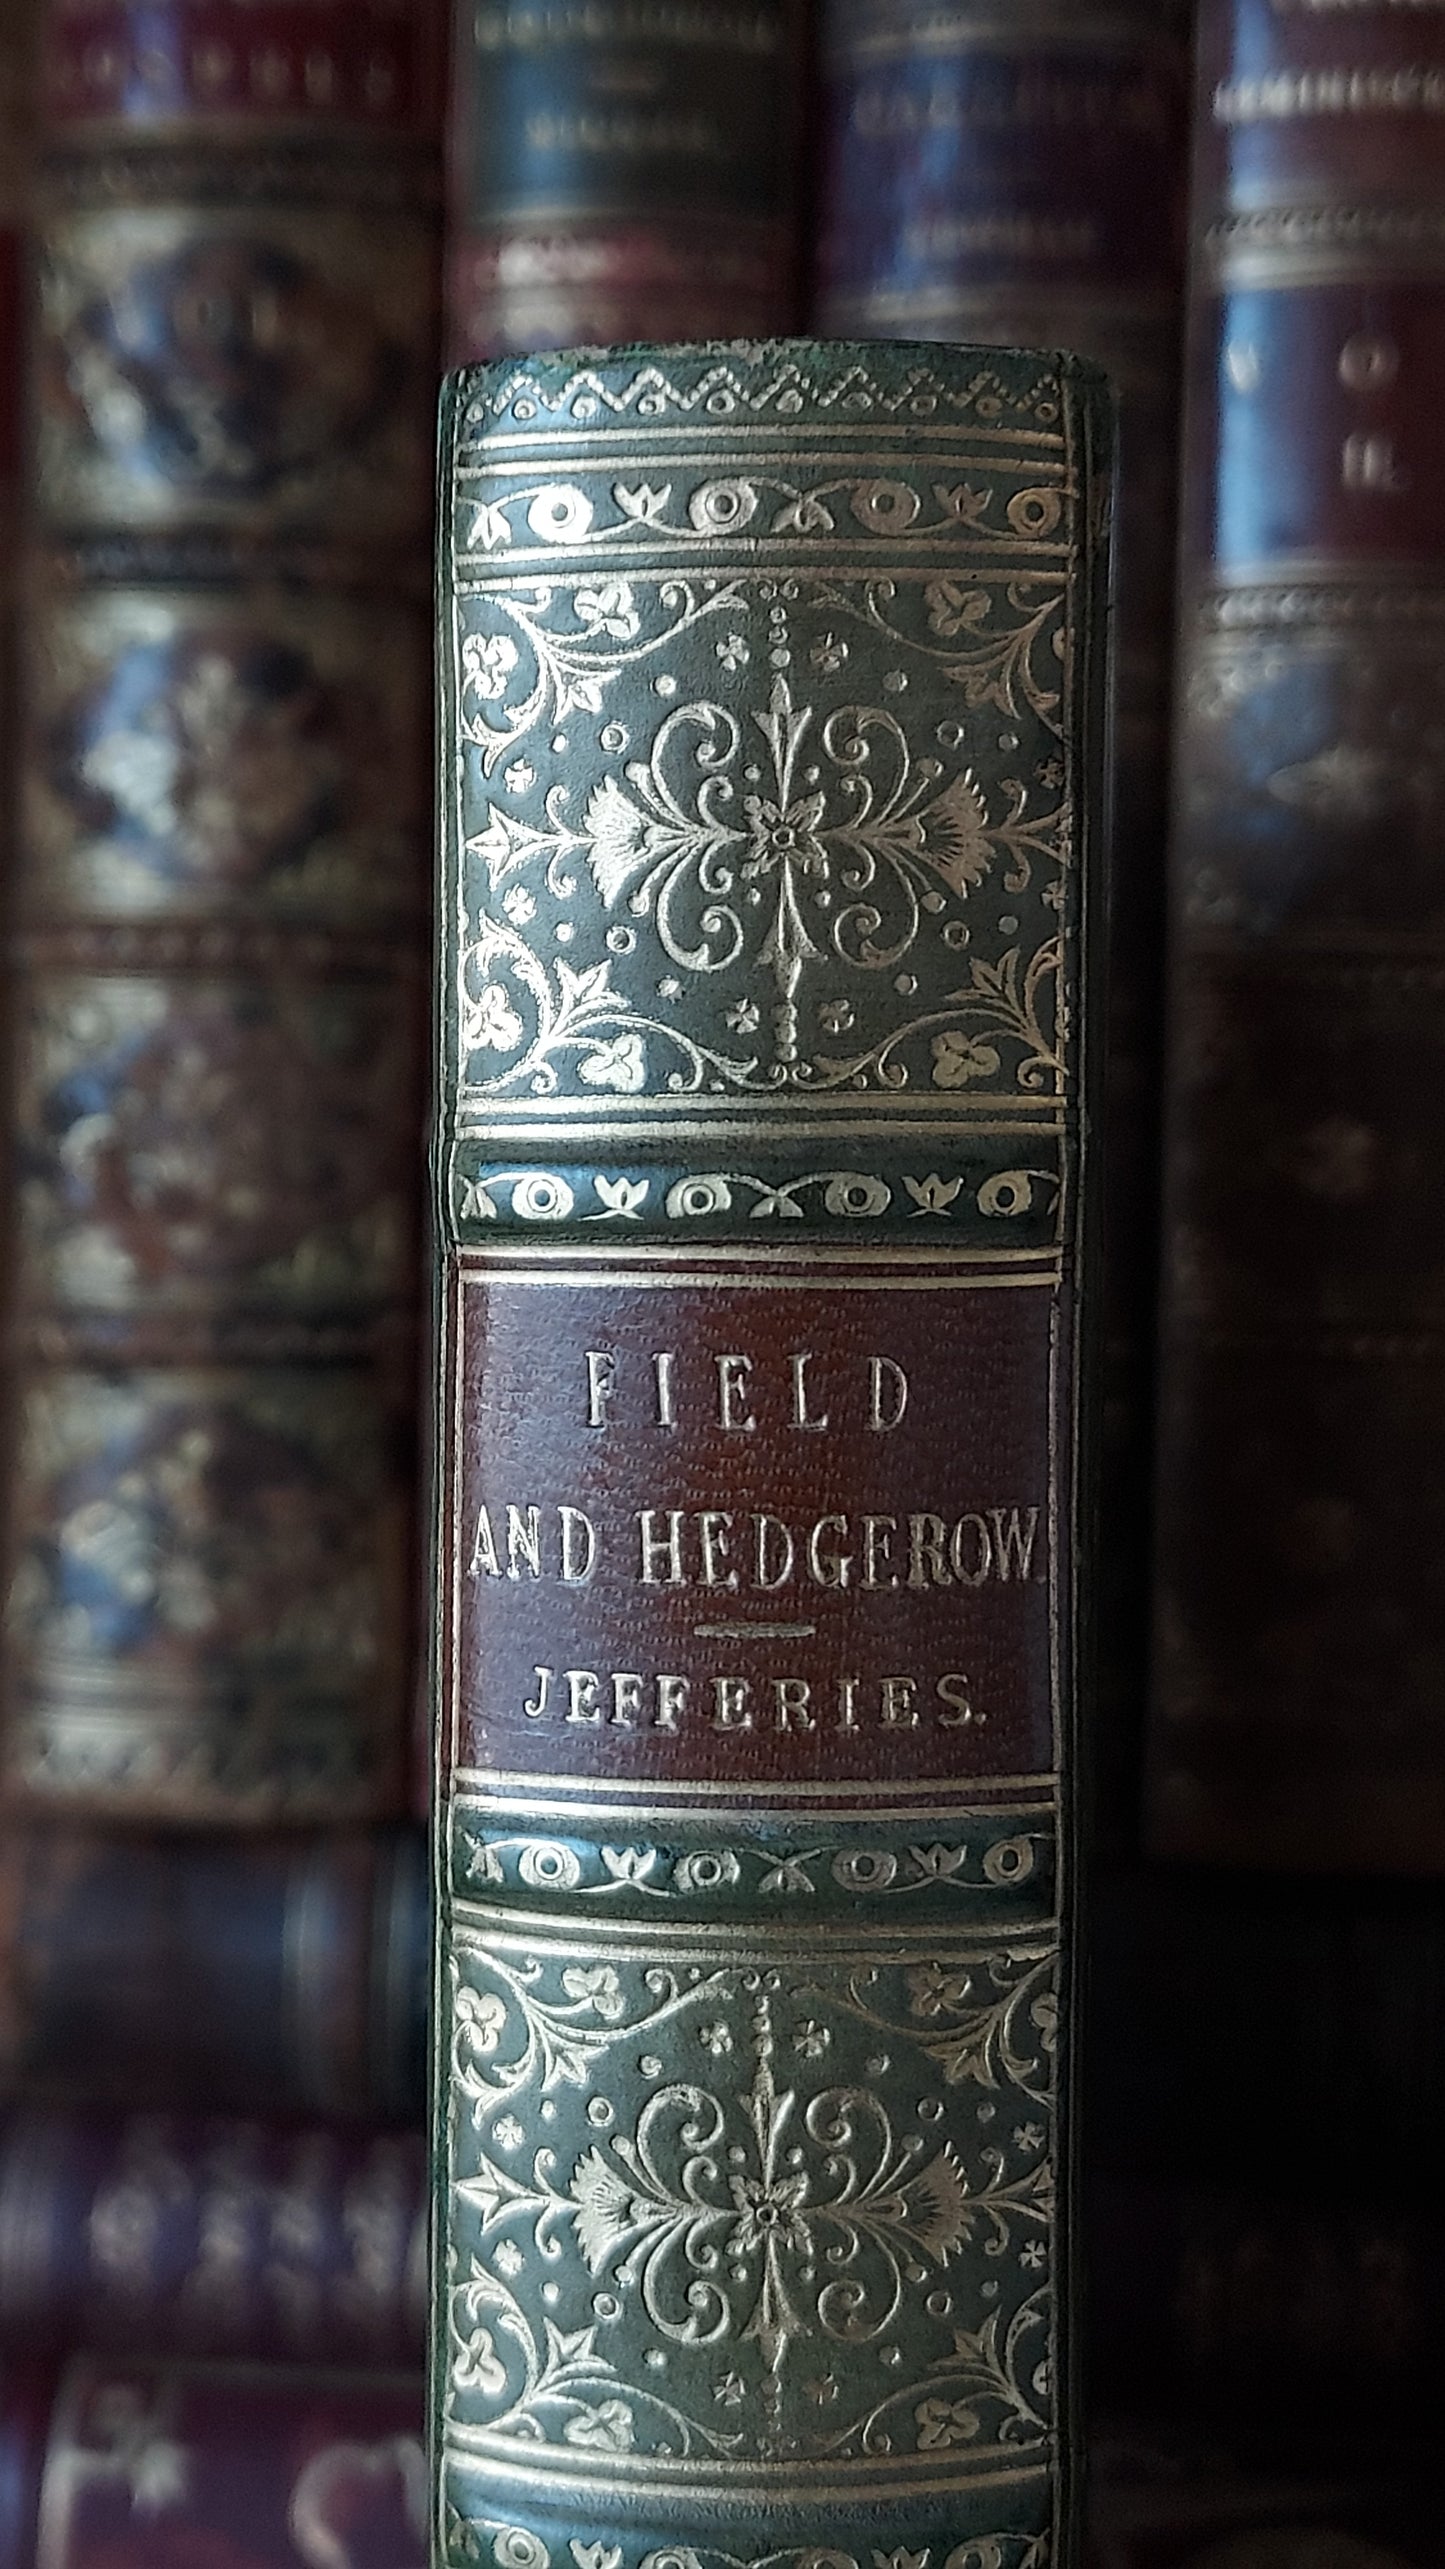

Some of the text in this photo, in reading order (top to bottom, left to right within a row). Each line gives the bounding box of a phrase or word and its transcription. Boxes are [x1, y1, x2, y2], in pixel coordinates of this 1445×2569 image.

[585, 1350, 908, 1431] FIELD
[467, 1504, 596, 1583] AND
[524, 1666, 988, 1732] JEFFERIES.
